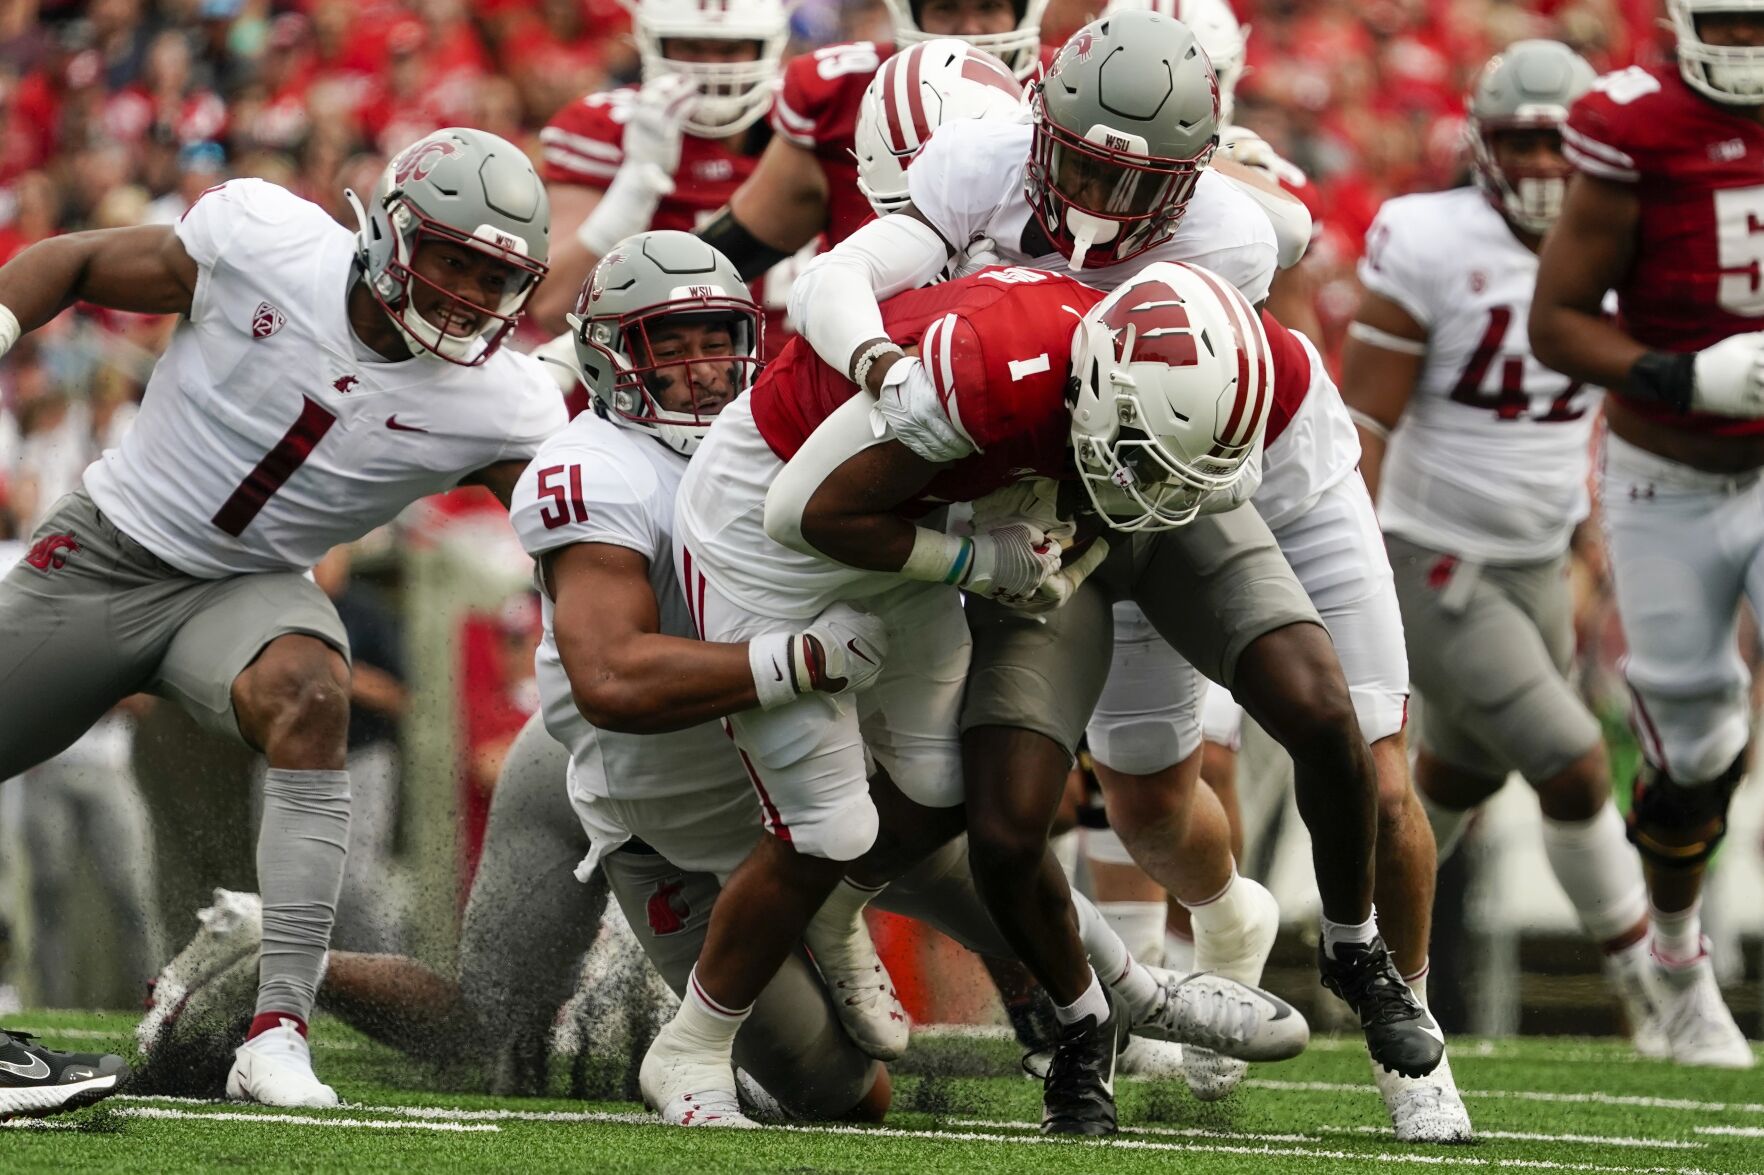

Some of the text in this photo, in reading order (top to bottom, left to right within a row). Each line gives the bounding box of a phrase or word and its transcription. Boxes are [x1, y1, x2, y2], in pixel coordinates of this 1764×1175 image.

[1105, 134, 1130, 152] WSU
[496, 234, 517, 250] WSU
[689, 286, 713, 298] WSU
[253, 317, 273, 336] 12
[1008, 353, 1051, 382] 1
[211, 393, 337, 538] 1
[537, 464, 589, 530] 51
